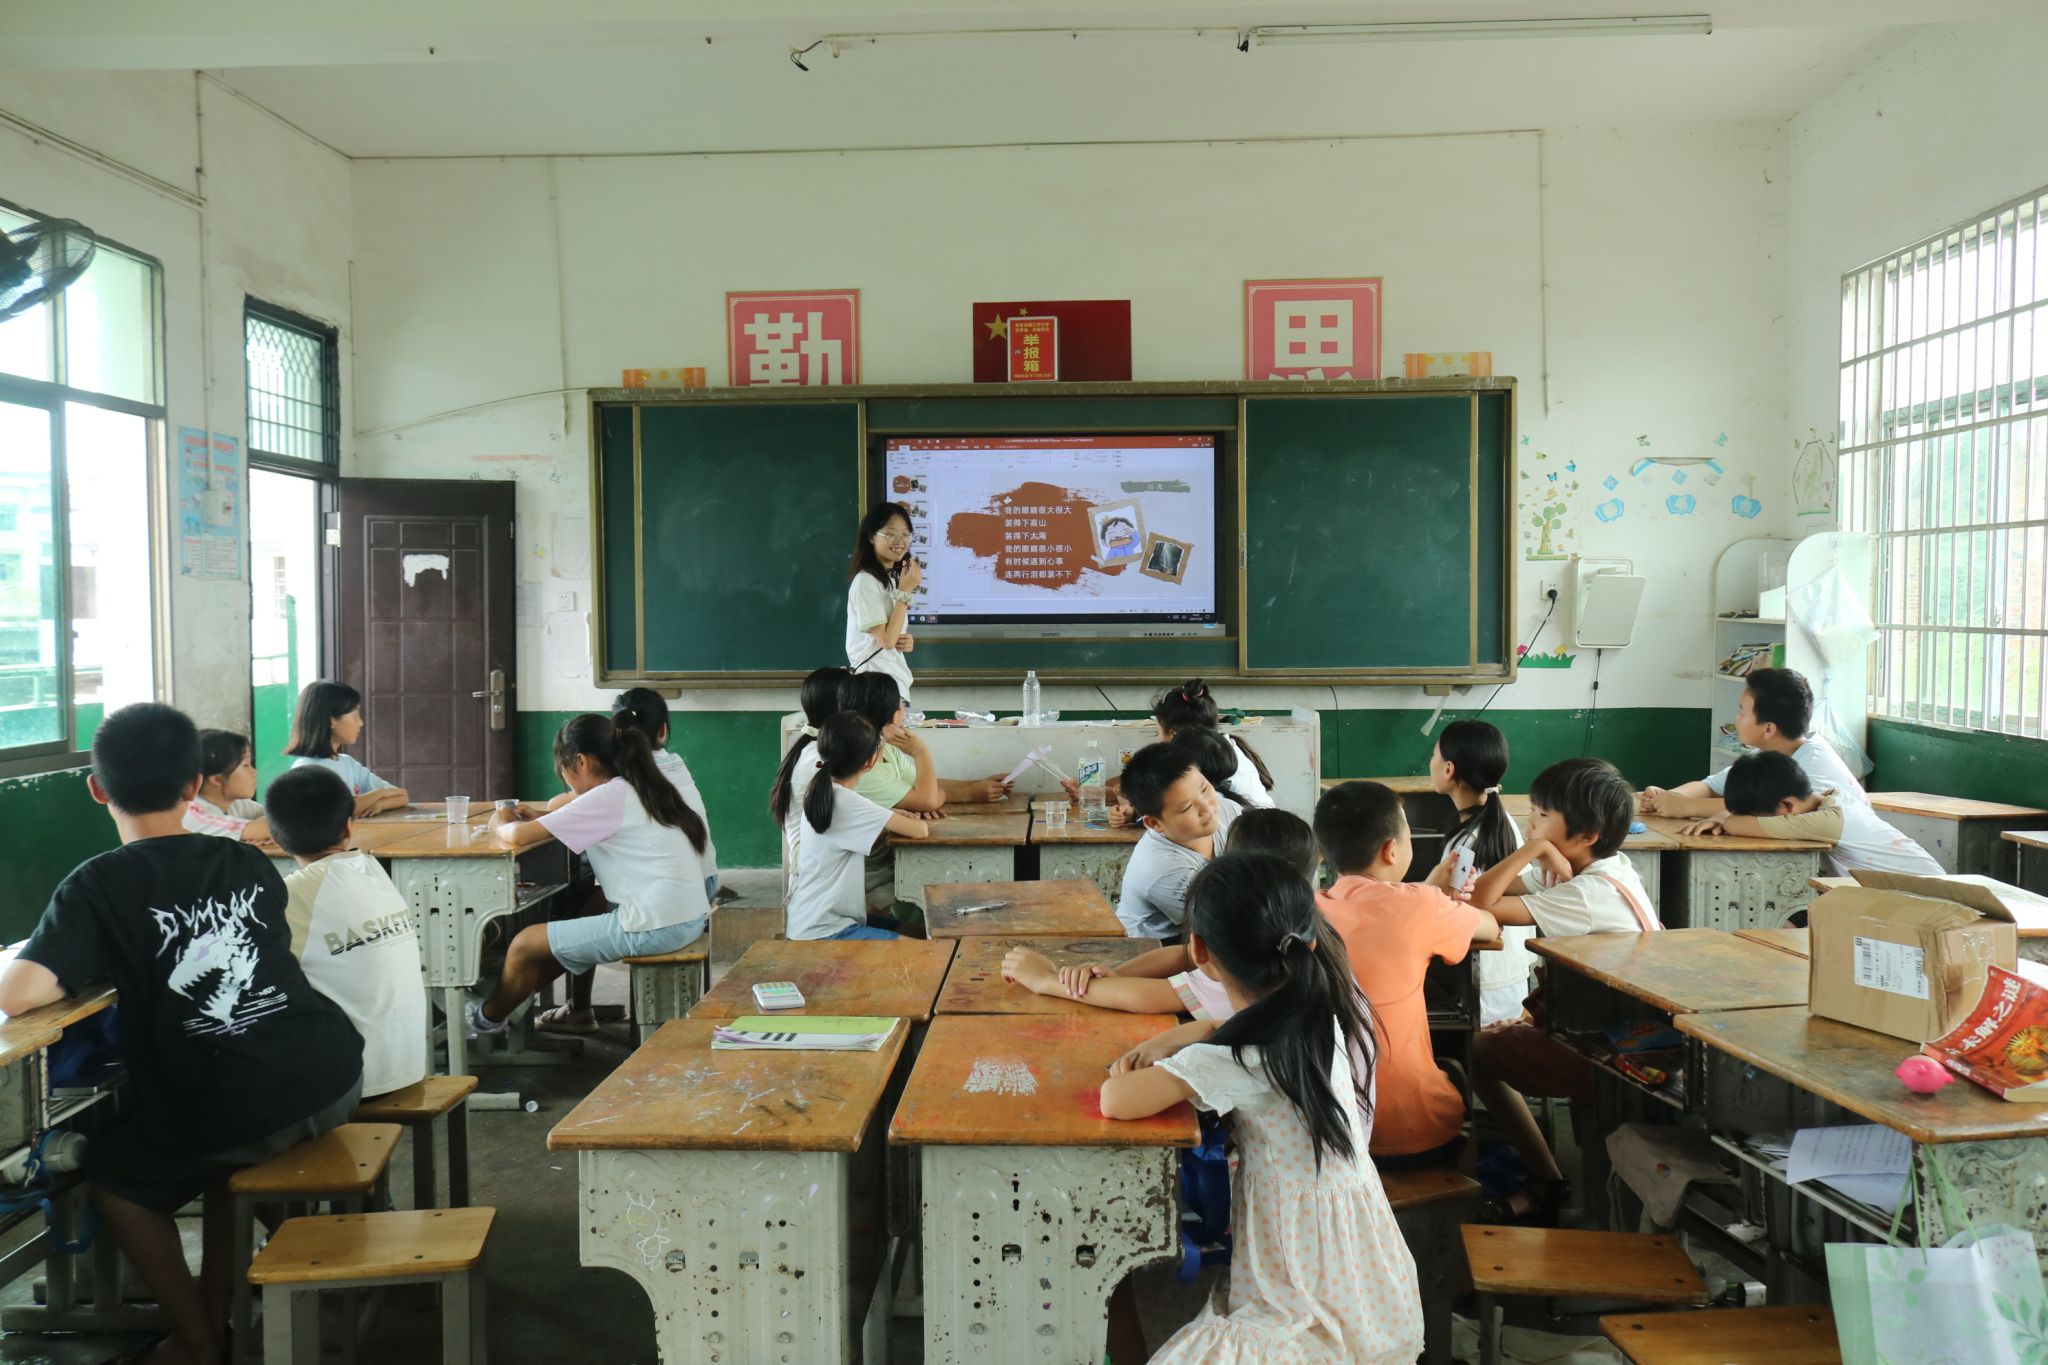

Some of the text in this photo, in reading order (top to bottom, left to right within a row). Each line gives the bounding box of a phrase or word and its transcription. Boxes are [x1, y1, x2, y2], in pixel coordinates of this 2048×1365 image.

[743, 311, 843, 387] 勤
[1023, 334, 1040, 372] 举报箱
[1005, 505, 1072, 515] 我的眼睛很大很大
[1005, 518, 1047, 528] 装得下高山
[1005, 531, 1047, 541] 装得下大海
[1005, 544, 1072, 554] 我的眼睛很小很小
[1005, 557, 1064, 567] 有时候遇到心事
[1005, 570, 1072, 580] 连两行泪都装不下
